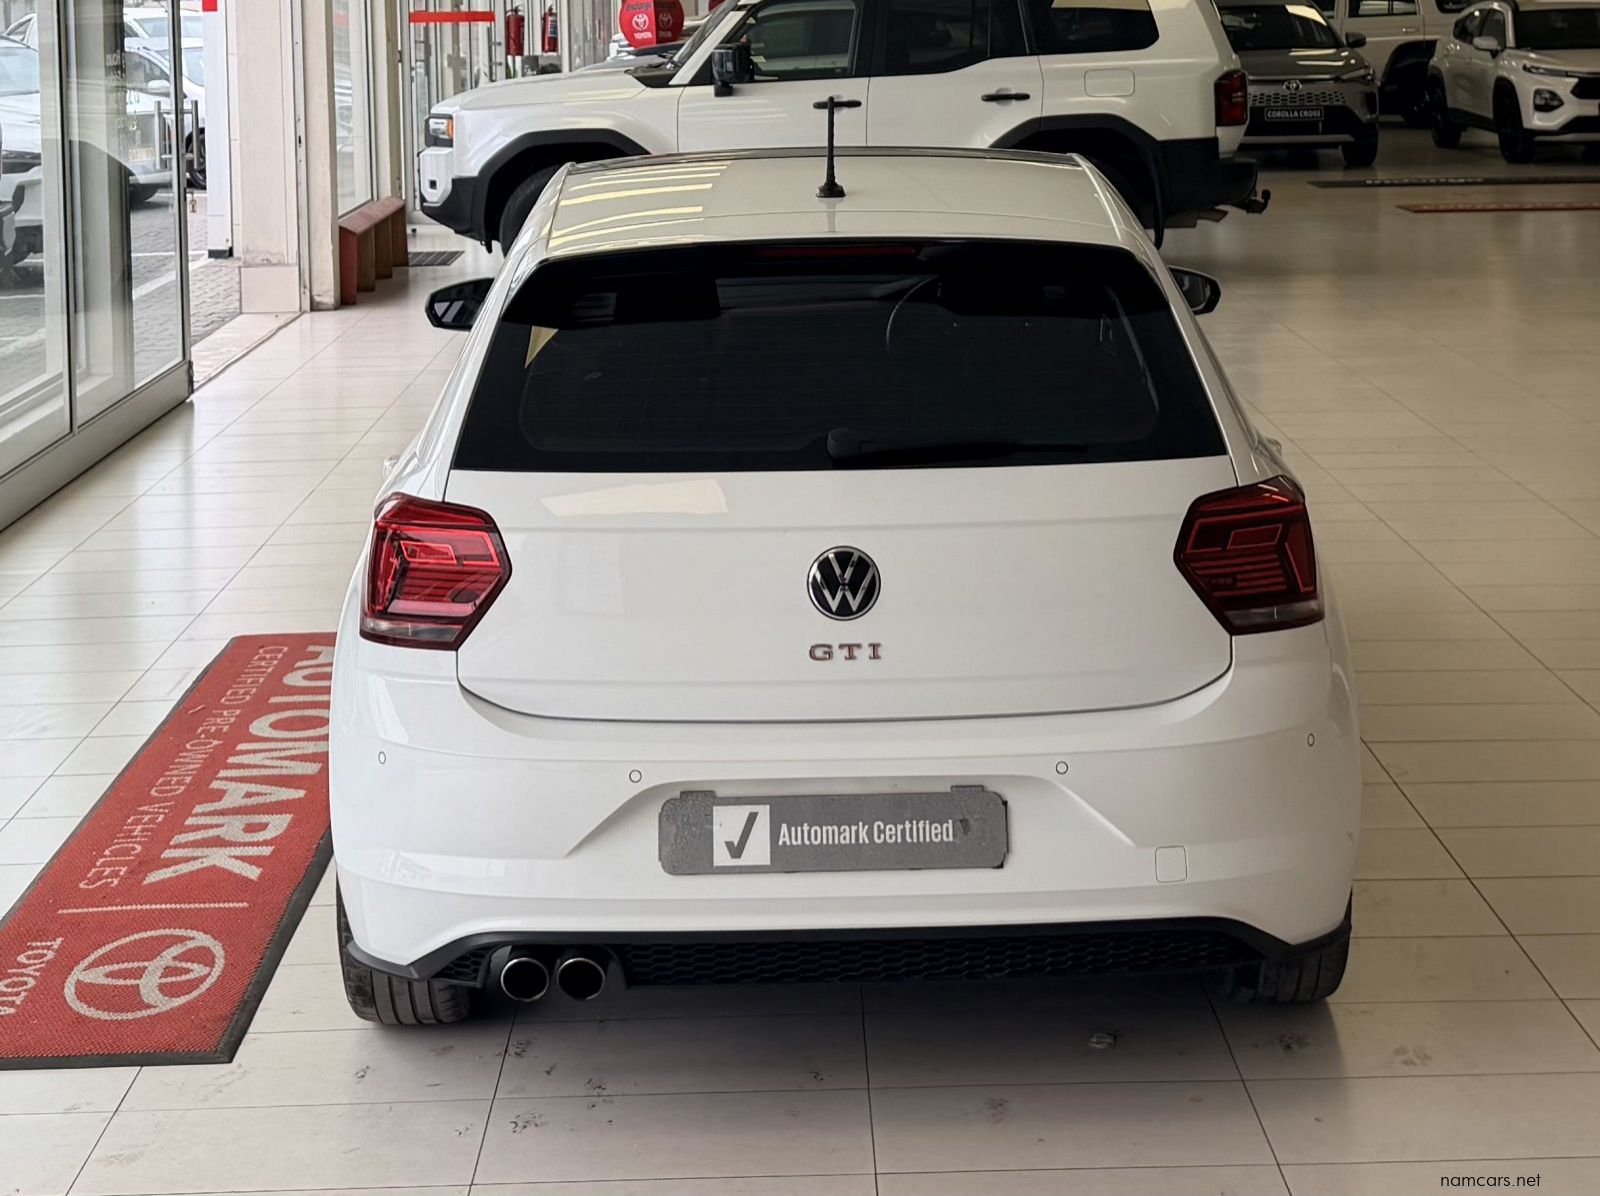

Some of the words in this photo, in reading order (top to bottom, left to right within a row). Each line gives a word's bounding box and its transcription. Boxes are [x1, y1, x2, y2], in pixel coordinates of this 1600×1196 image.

[1267, 110, 1298, 118] COROLLA
[1300, 109, 1321, 117] CROSS
[808, 643, 882, 661] GTI
[220, 645, 288, 705] CERTIFIED
[149, 708, 242, 798] PRE-OWNED
[78, 801, 175, 889] VEHICLES
[777, 821, 869, 847] Automark
[872, 818, 954, 844] Certified
